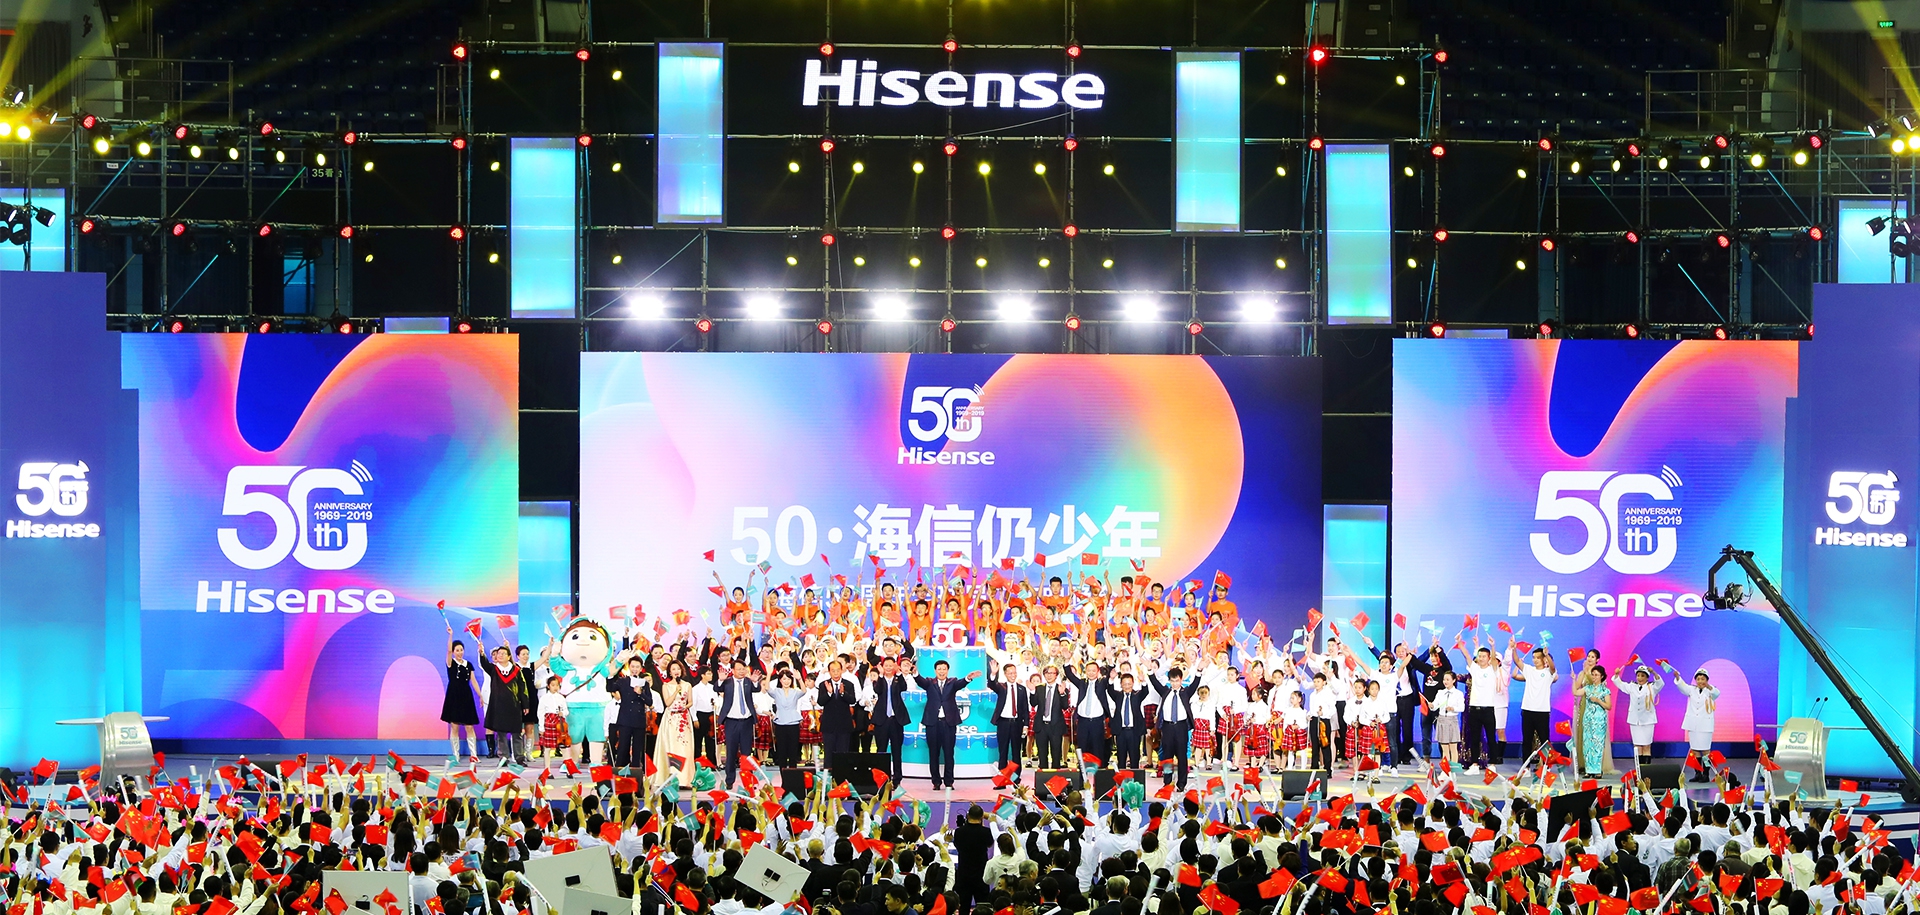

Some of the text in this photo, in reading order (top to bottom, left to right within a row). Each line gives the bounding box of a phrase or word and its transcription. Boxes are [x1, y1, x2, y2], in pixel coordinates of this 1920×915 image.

[802, 59, 1106, 109] Hisense
[898, 447, 996, 465] Hisense
[217, 466, 368, 570] 50
[314, 511, 373, 520] 1969-2019
[1529, 471, 1678, 574] 50
[1624, 507, 1683, 515] ANNIVERSARY
[1624, 516, 1683, 525] 1969-2019
[6, 519, 101, 538] Hisense
[313, 522, 343, 547] th
[1624, 527, 1653, 552] th
[1815, 527, 1908, 547] Hisense
[196, 580, 395, 614] Hisense
[1507, 585, 1704, 617] Hisense
